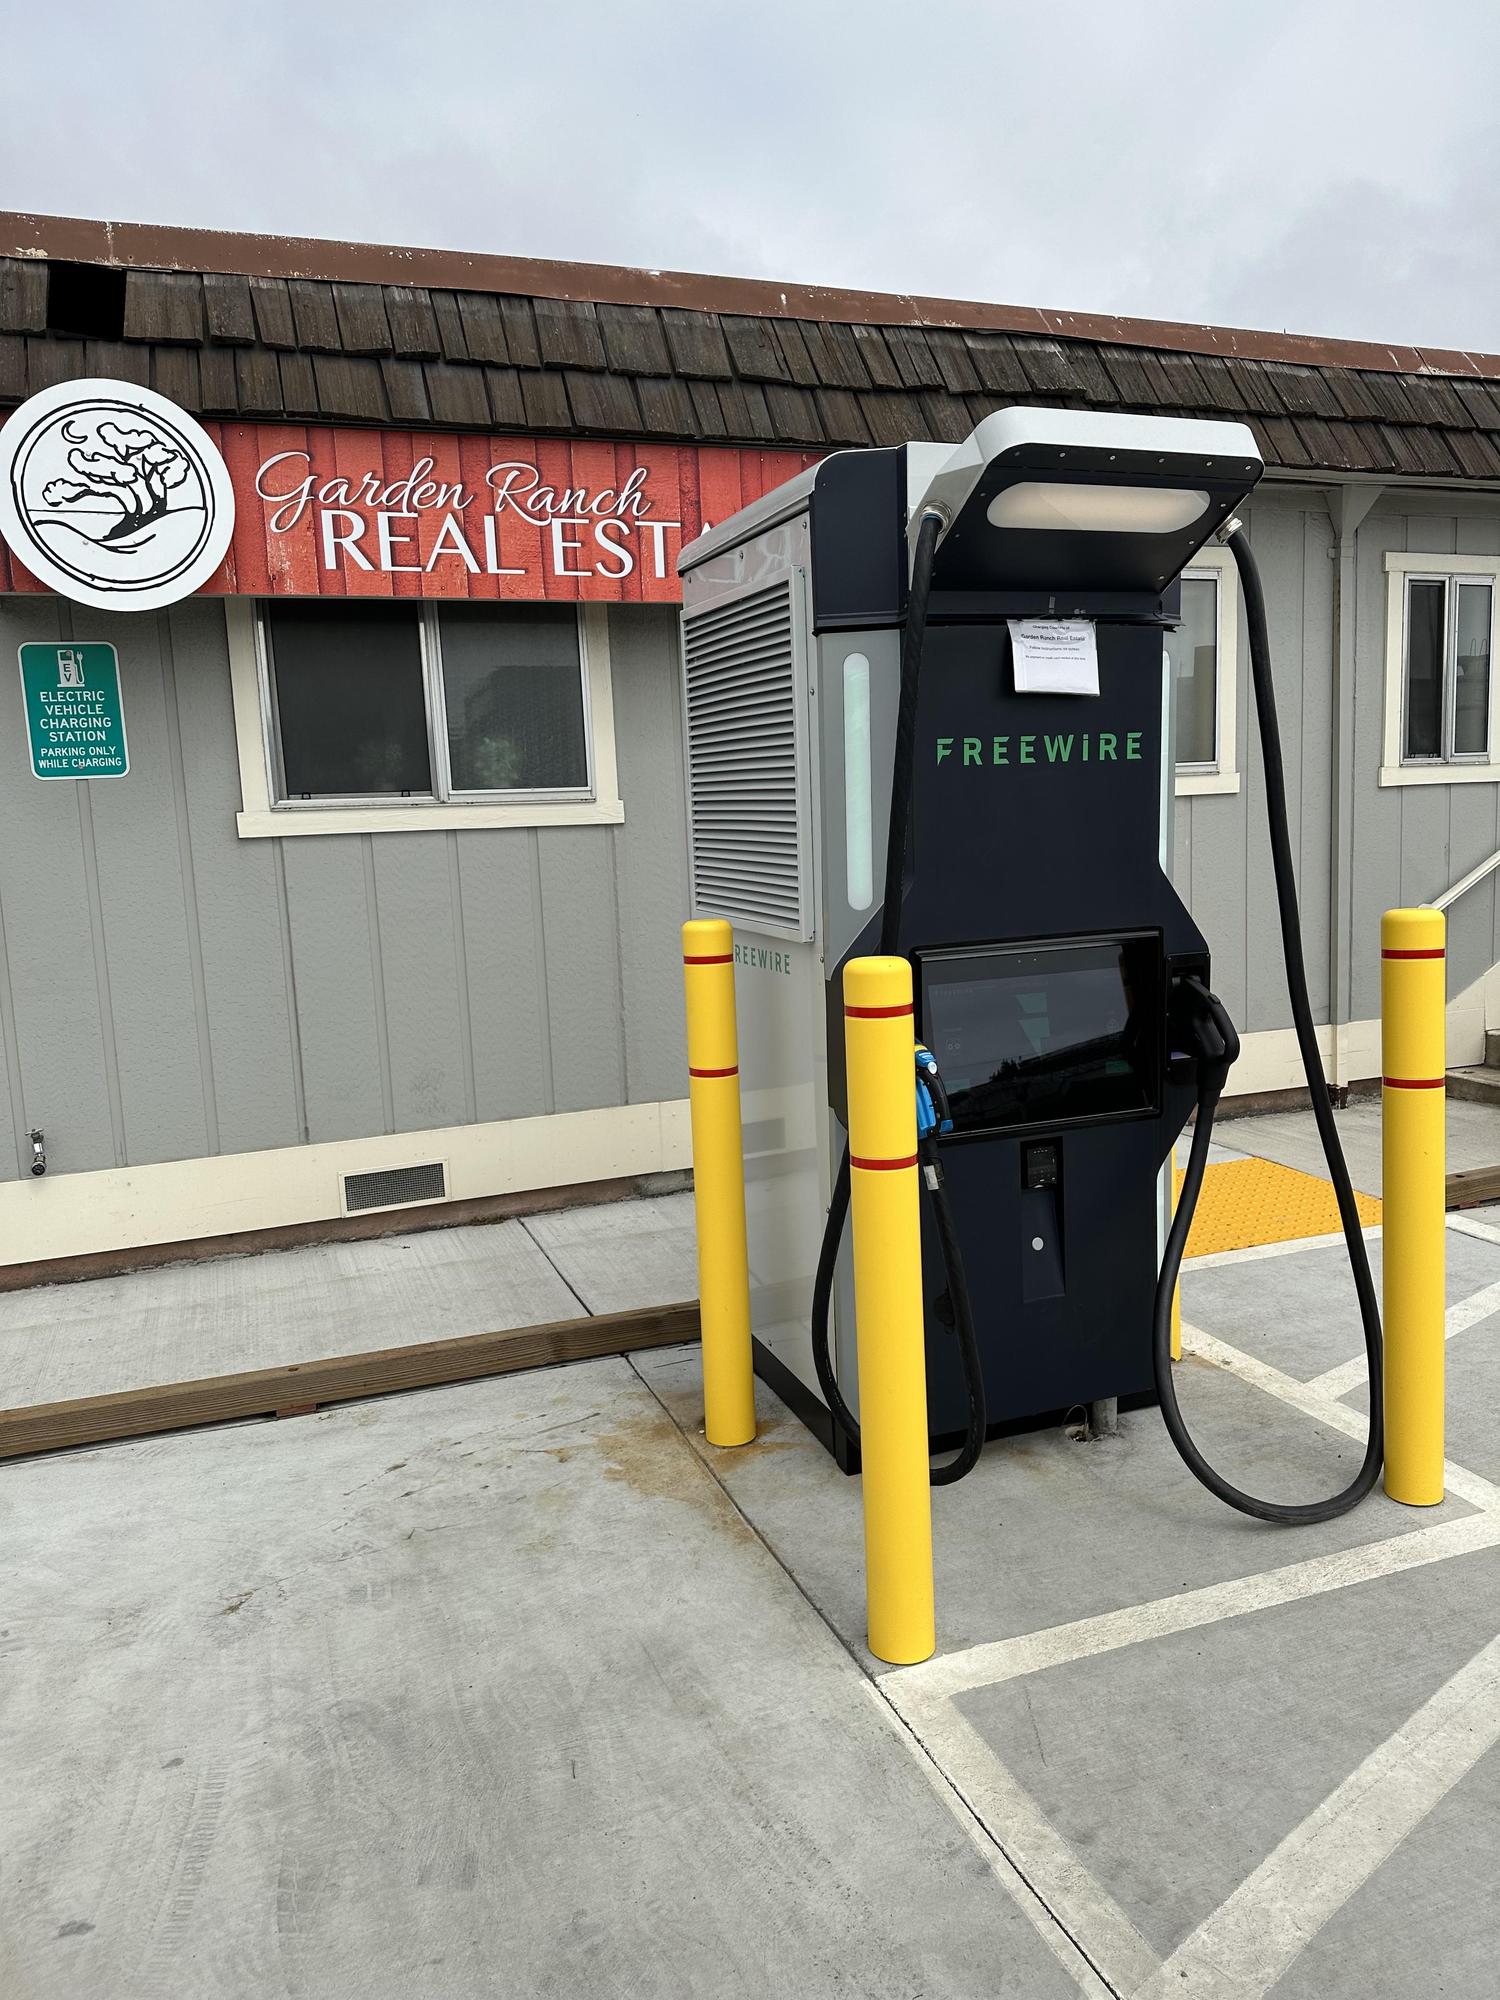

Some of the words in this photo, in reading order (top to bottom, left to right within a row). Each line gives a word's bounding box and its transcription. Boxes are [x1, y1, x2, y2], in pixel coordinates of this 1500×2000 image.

[255, 452, 474, 533] Garden
[485, 461, 651, 527] Ranch
[322, 509, 526, 575] REAL
[553, 518, 712, 579] EST
[40, 691, 105, 702] ELECTRIC
[45, 704, 104, 715] VEHICLE
[40, 717, 112, 729] CHARGING
[50, 731, 106, 742] STATION
[40, 748, 86, 757] PARKING
[88, 746, 117, 755] ONLY
[38, 759, 69, 769] WHILE
[71, 757, 122, 768] CHARGING
